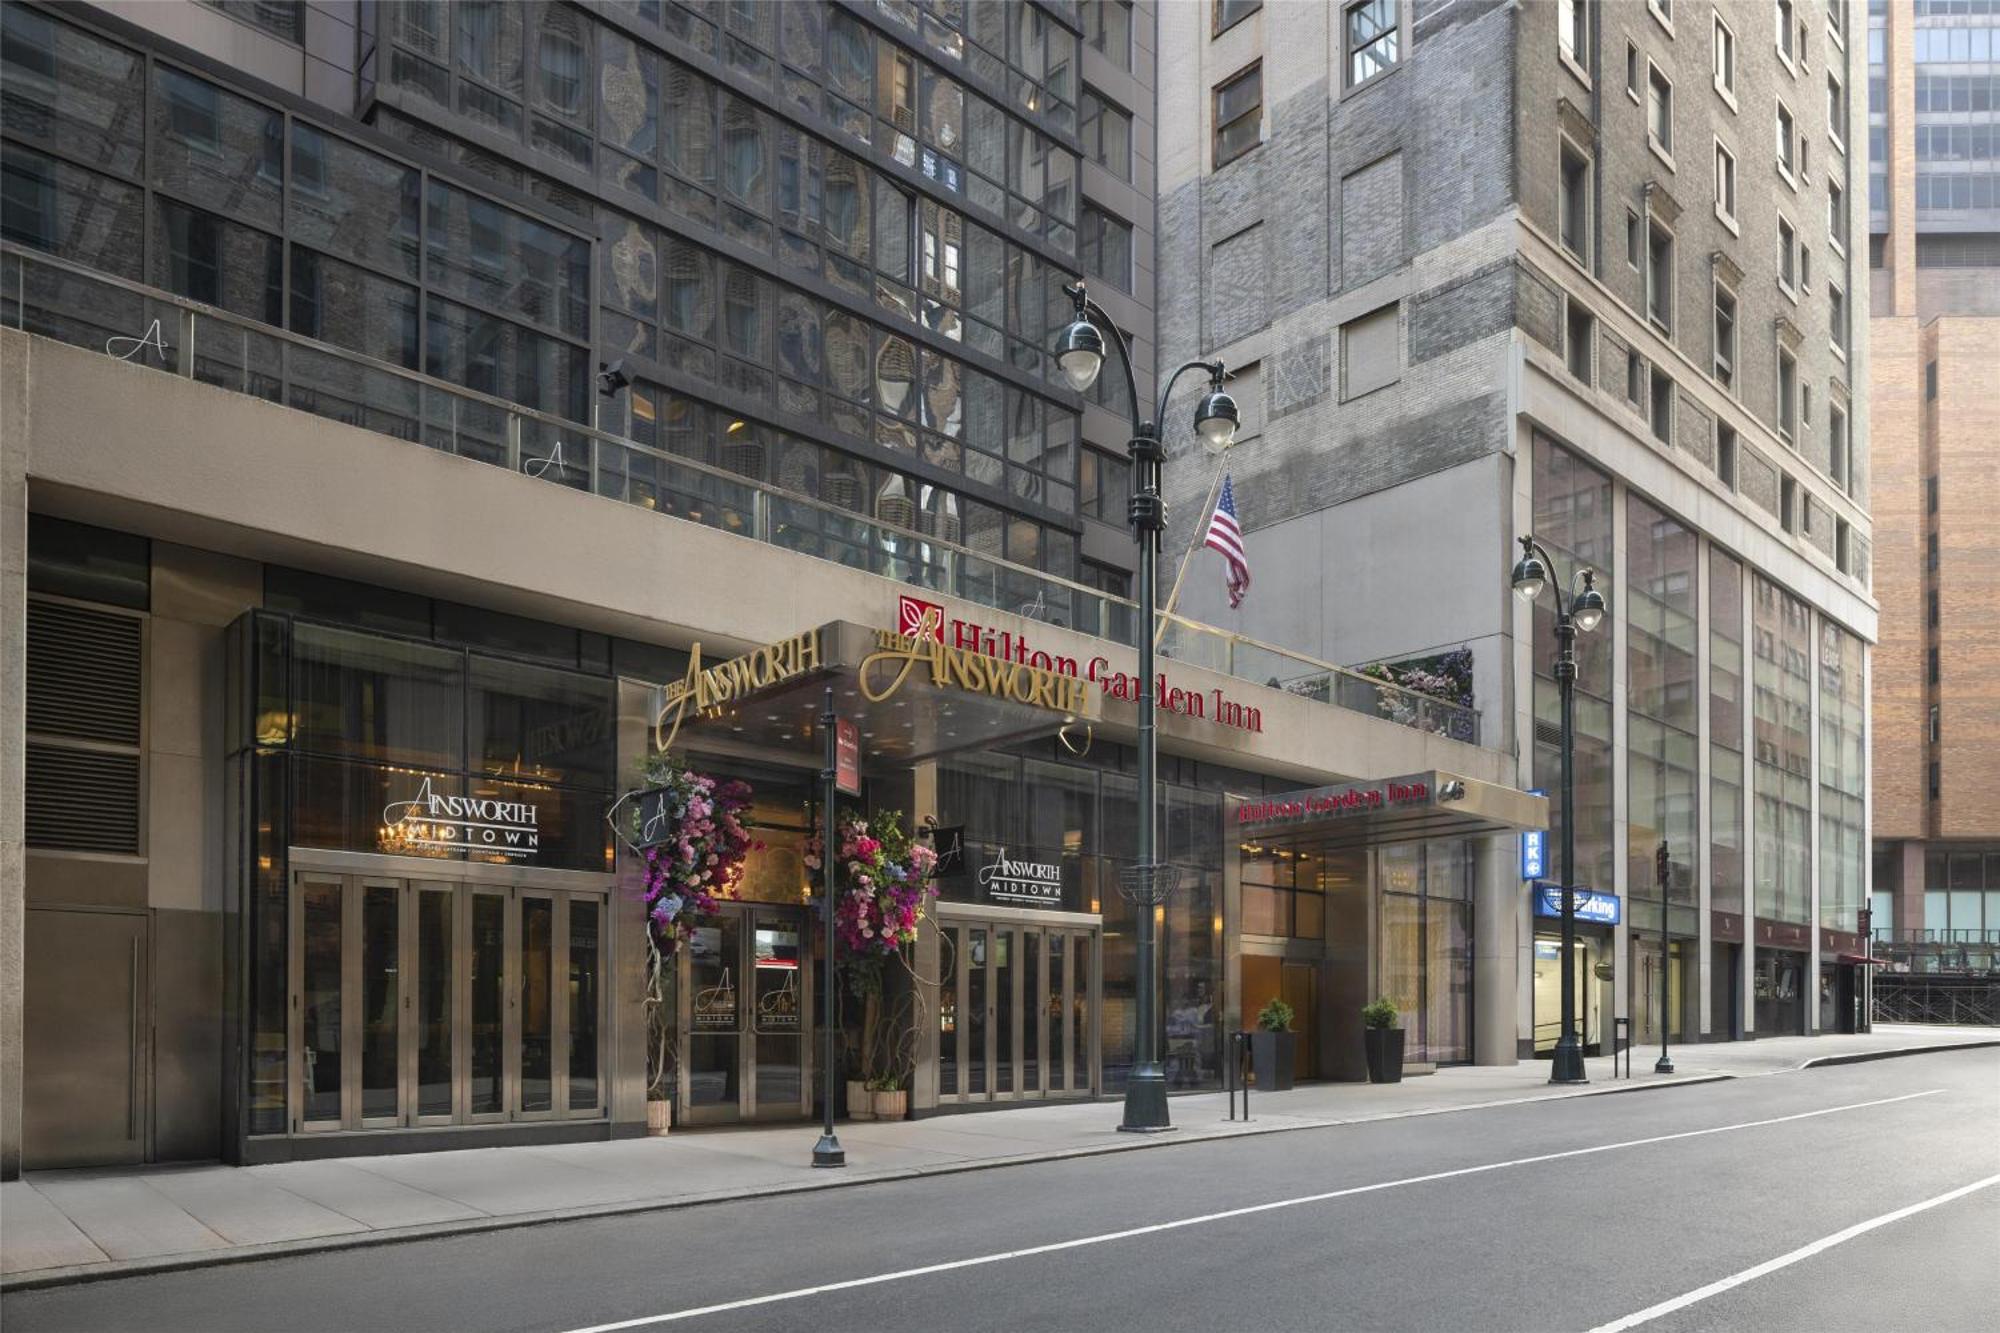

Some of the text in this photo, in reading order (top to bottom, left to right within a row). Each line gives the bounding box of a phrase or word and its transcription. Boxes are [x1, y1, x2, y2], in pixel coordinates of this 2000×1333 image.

[860, 606, 1089, 717] AINSWORTH
[953, 619, 1263, 733] Hilton Garden Inn
[656, 625, 820, 751] AINSWORTH
[383, 777, 538, 827] AINSWORTH
[1239, 782, 1428, 824] Hilton Garden Inn
[407, 823, 538, 847] MIDTOWN
[979, 847, 1060, 885] AINSWORTH
[990, 881, 1061, 897] MIDTOWN
